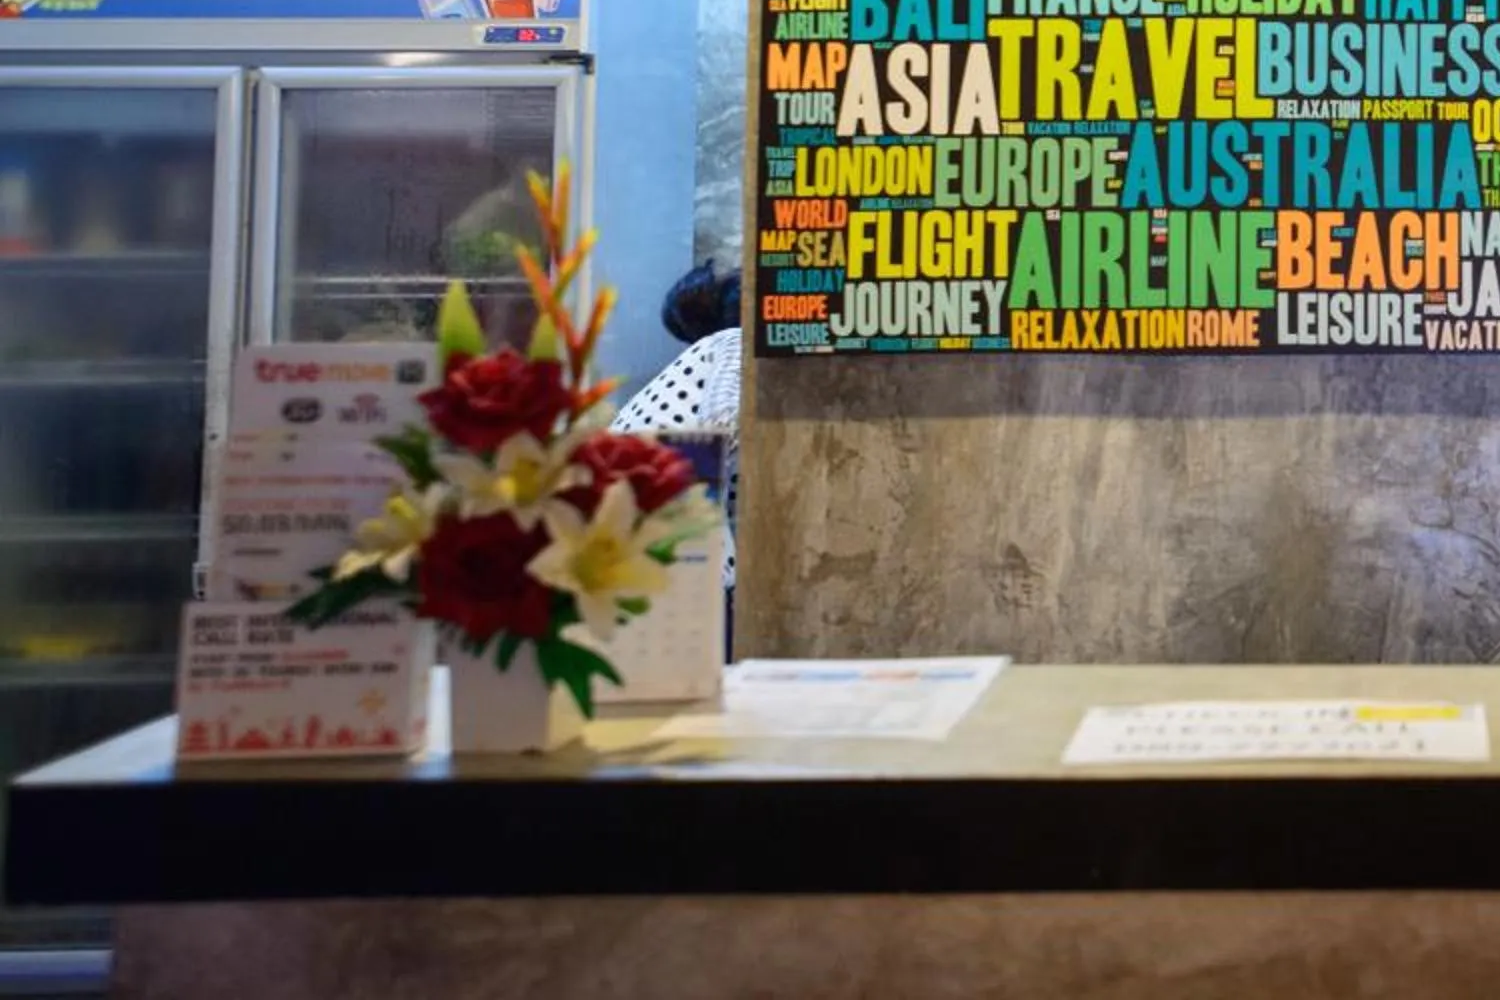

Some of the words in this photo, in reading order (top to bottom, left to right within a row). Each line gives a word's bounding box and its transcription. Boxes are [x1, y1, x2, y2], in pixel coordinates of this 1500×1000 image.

[774, 11, 849, 40] AIRLINE
[767, 42, 848, 90] MAP
[835, 42, 1001, 136] ASIA
[987, 17, 1275, 120] TRAVEL
[774, 92, 836, 126] TOUR
[1277, 99, 1361, 119] RELAXATION
[1362, 99, 1434, 120] PASSPORT
[1436, 101, 1470, 120] TOUR
[795, 145, 933, 197] LONDON
[934, 136, 1119, 207] EUROPE
[1119, 120, 1481, 210] AUSTRALIA
[773, 198, 849, 230] WORLD
[760, 230, 798, 251] MAP
[796, 230, 847, 268] SEA
[847, 210, 1018, 279] FLIGHT
[1008, 210, 1276, 309] AIRLINE
[1276, 210, 1461, 291] BEACH
[775, 268, 846, 293] HOLIDAY
[762, 294, 829, 321] EUROPE
[829, 280, 1008, 338] JOURNEY
[1010, 310, 1187, 350] RELAXATION
[1187, 309, 1260, 348] ROME
[1276, 292, 1424, 347] LEISURE
[767, 322, 831, 346] LEISURE
